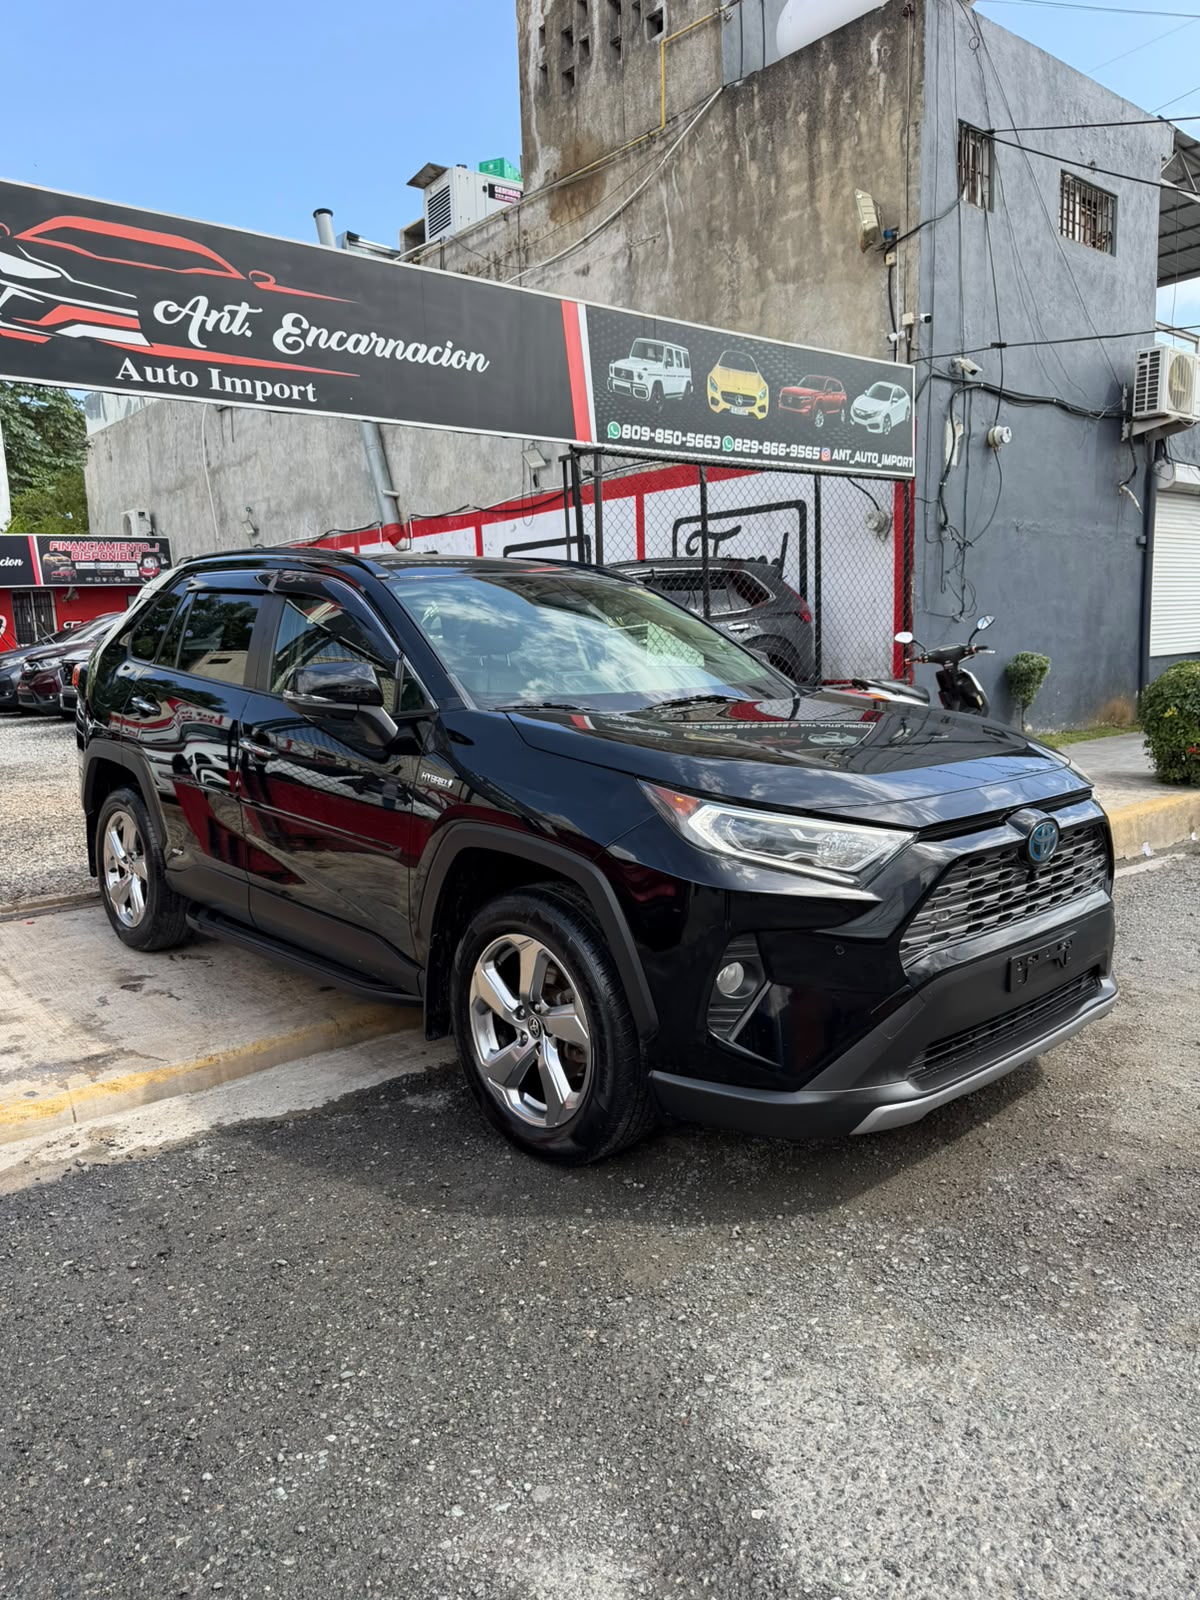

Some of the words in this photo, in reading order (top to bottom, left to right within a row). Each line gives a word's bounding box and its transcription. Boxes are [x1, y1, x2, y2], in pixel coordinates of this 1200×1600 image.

[153, 295, 263, 349] Ant.
[272, 312, 490, 373] Encarnacion
[115, 357, 199, 389] Auto
[208, 367, 317, 402] Import
[621, 424, 721, 449] 809-850-5663
[734, 438, 821, 460] 829-866-9565
[832, 448, 914, 469] ANT_AUTO_IMPORT
[71, 551, 141, 562] DISPONIBLE
